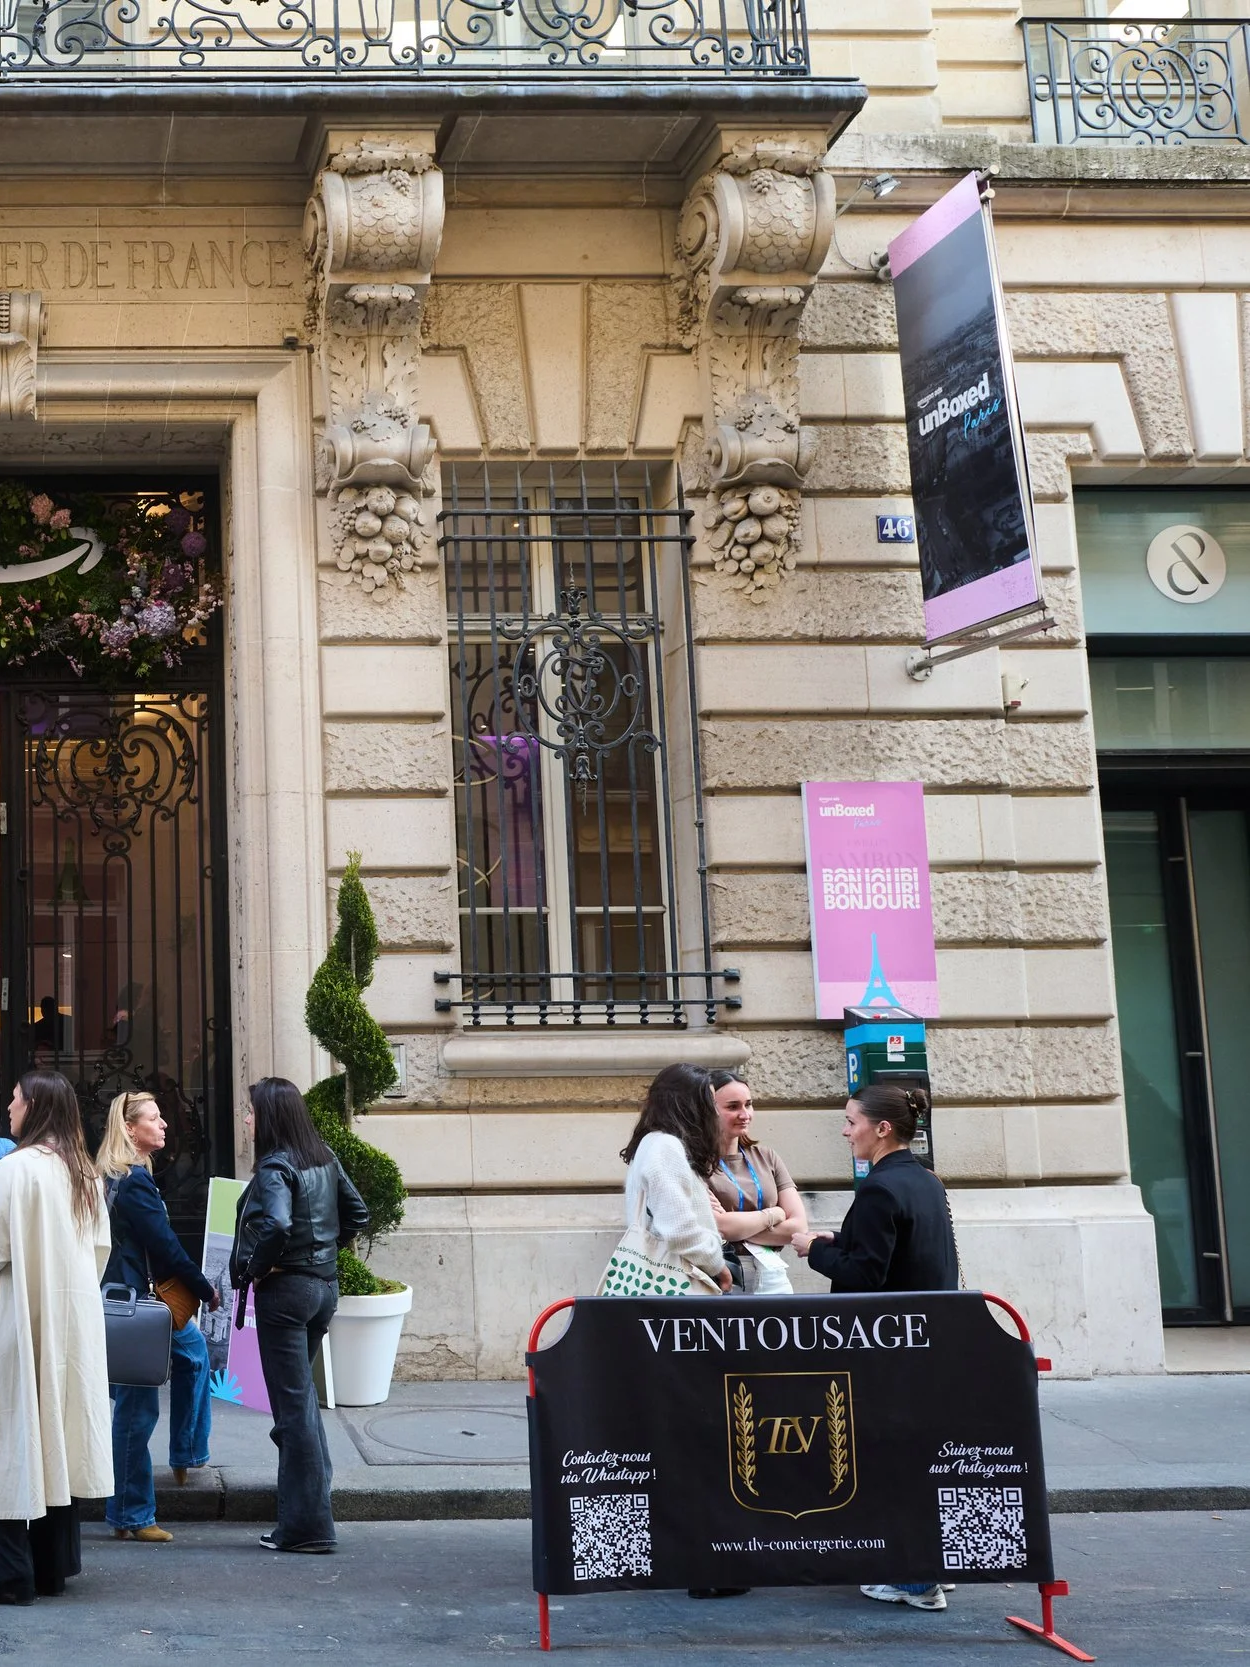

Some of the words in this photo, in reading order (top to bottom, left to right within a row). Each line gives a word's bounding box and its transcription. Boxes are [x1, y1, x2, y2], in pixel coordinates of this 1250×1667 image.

[61, 240, 116, 290] DE
[123, 240, 294, 290] FRANCE
[918, 372, 991, 436] unBoxed
[963, 398, 1001, 440] Paris
[881, 518, 912, 539] 46
[819, 803, 875, 817] unBoxed
[824, 893, 921, 910] BONJOUR!
[638, 1313, 931, 1353] VENTOUSAGE
[562, 1449, 652, 1469] Contactez-nous
[937, 1440, 1014, 1461] Suivez-nous
[560, 1470, 581, 1484] via
[581, 1466, 651, 1485] Whastapp
[928, 1463, 951, 1474] sur
[951, 1459, 1023, 1479] Instagram
[711, 1535, 886, 1554] www.tlv-conciergerie.com
